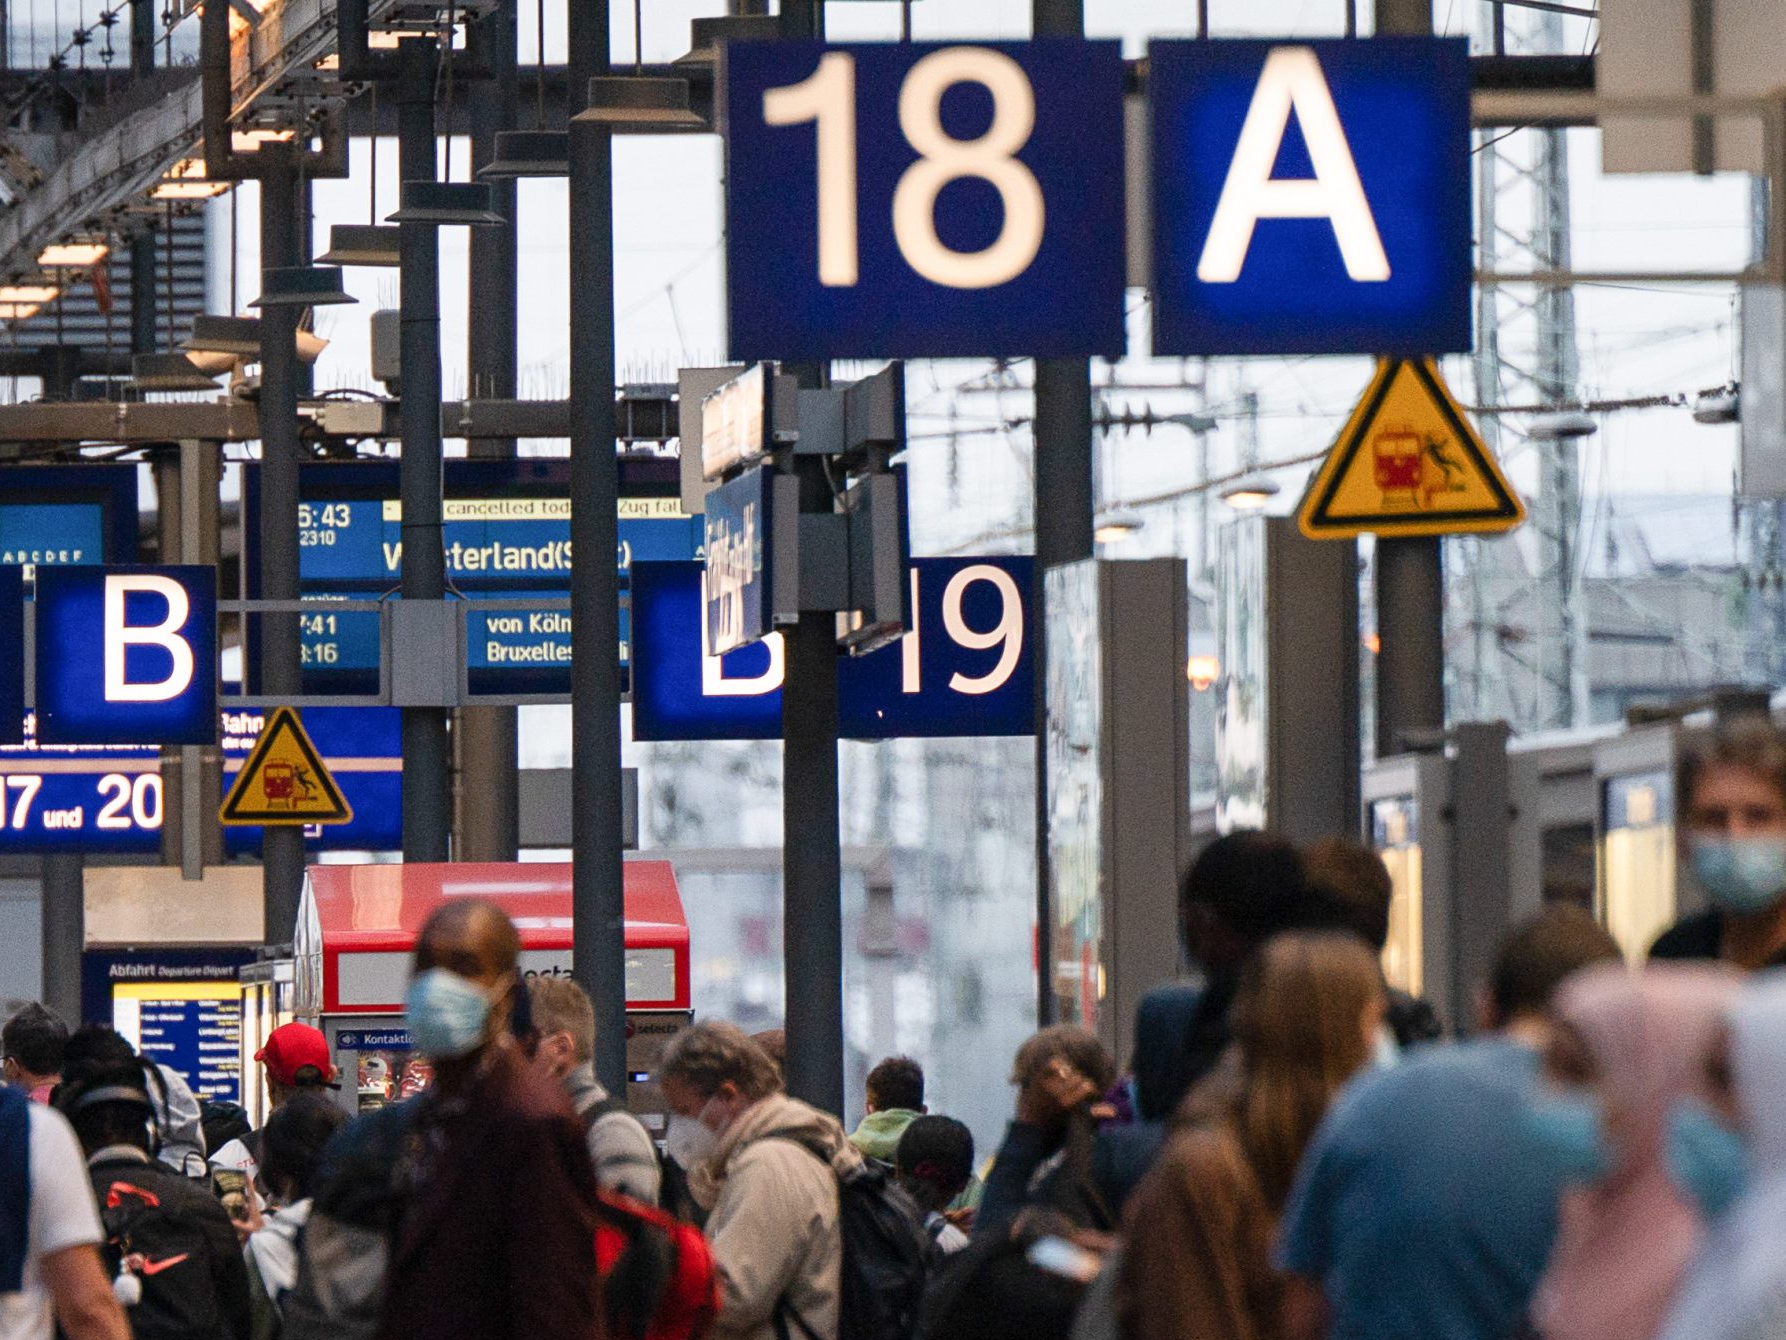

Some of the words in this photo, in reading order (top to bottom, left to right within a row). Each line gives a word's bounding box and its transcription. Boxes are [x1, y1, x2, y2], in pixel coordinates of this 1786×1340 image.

[763, 46, 1045, 289] 18
[1197, 46, 1391, 282] A
[299, 504, 350, 527] 6:43
[447, 502, 534, 514] cancelled
[542, 502, 570, 513] tod
[3, 552, 13, 562] A
[487, 618, 522, 633] von
[104, 575, 194, 702] B
[43, 806, 83, 828] und
[96, 773, 163, 829] 20
[109, 963, 156, 977] Abfahrt
[637, 1024, 679, 1034] selecta
